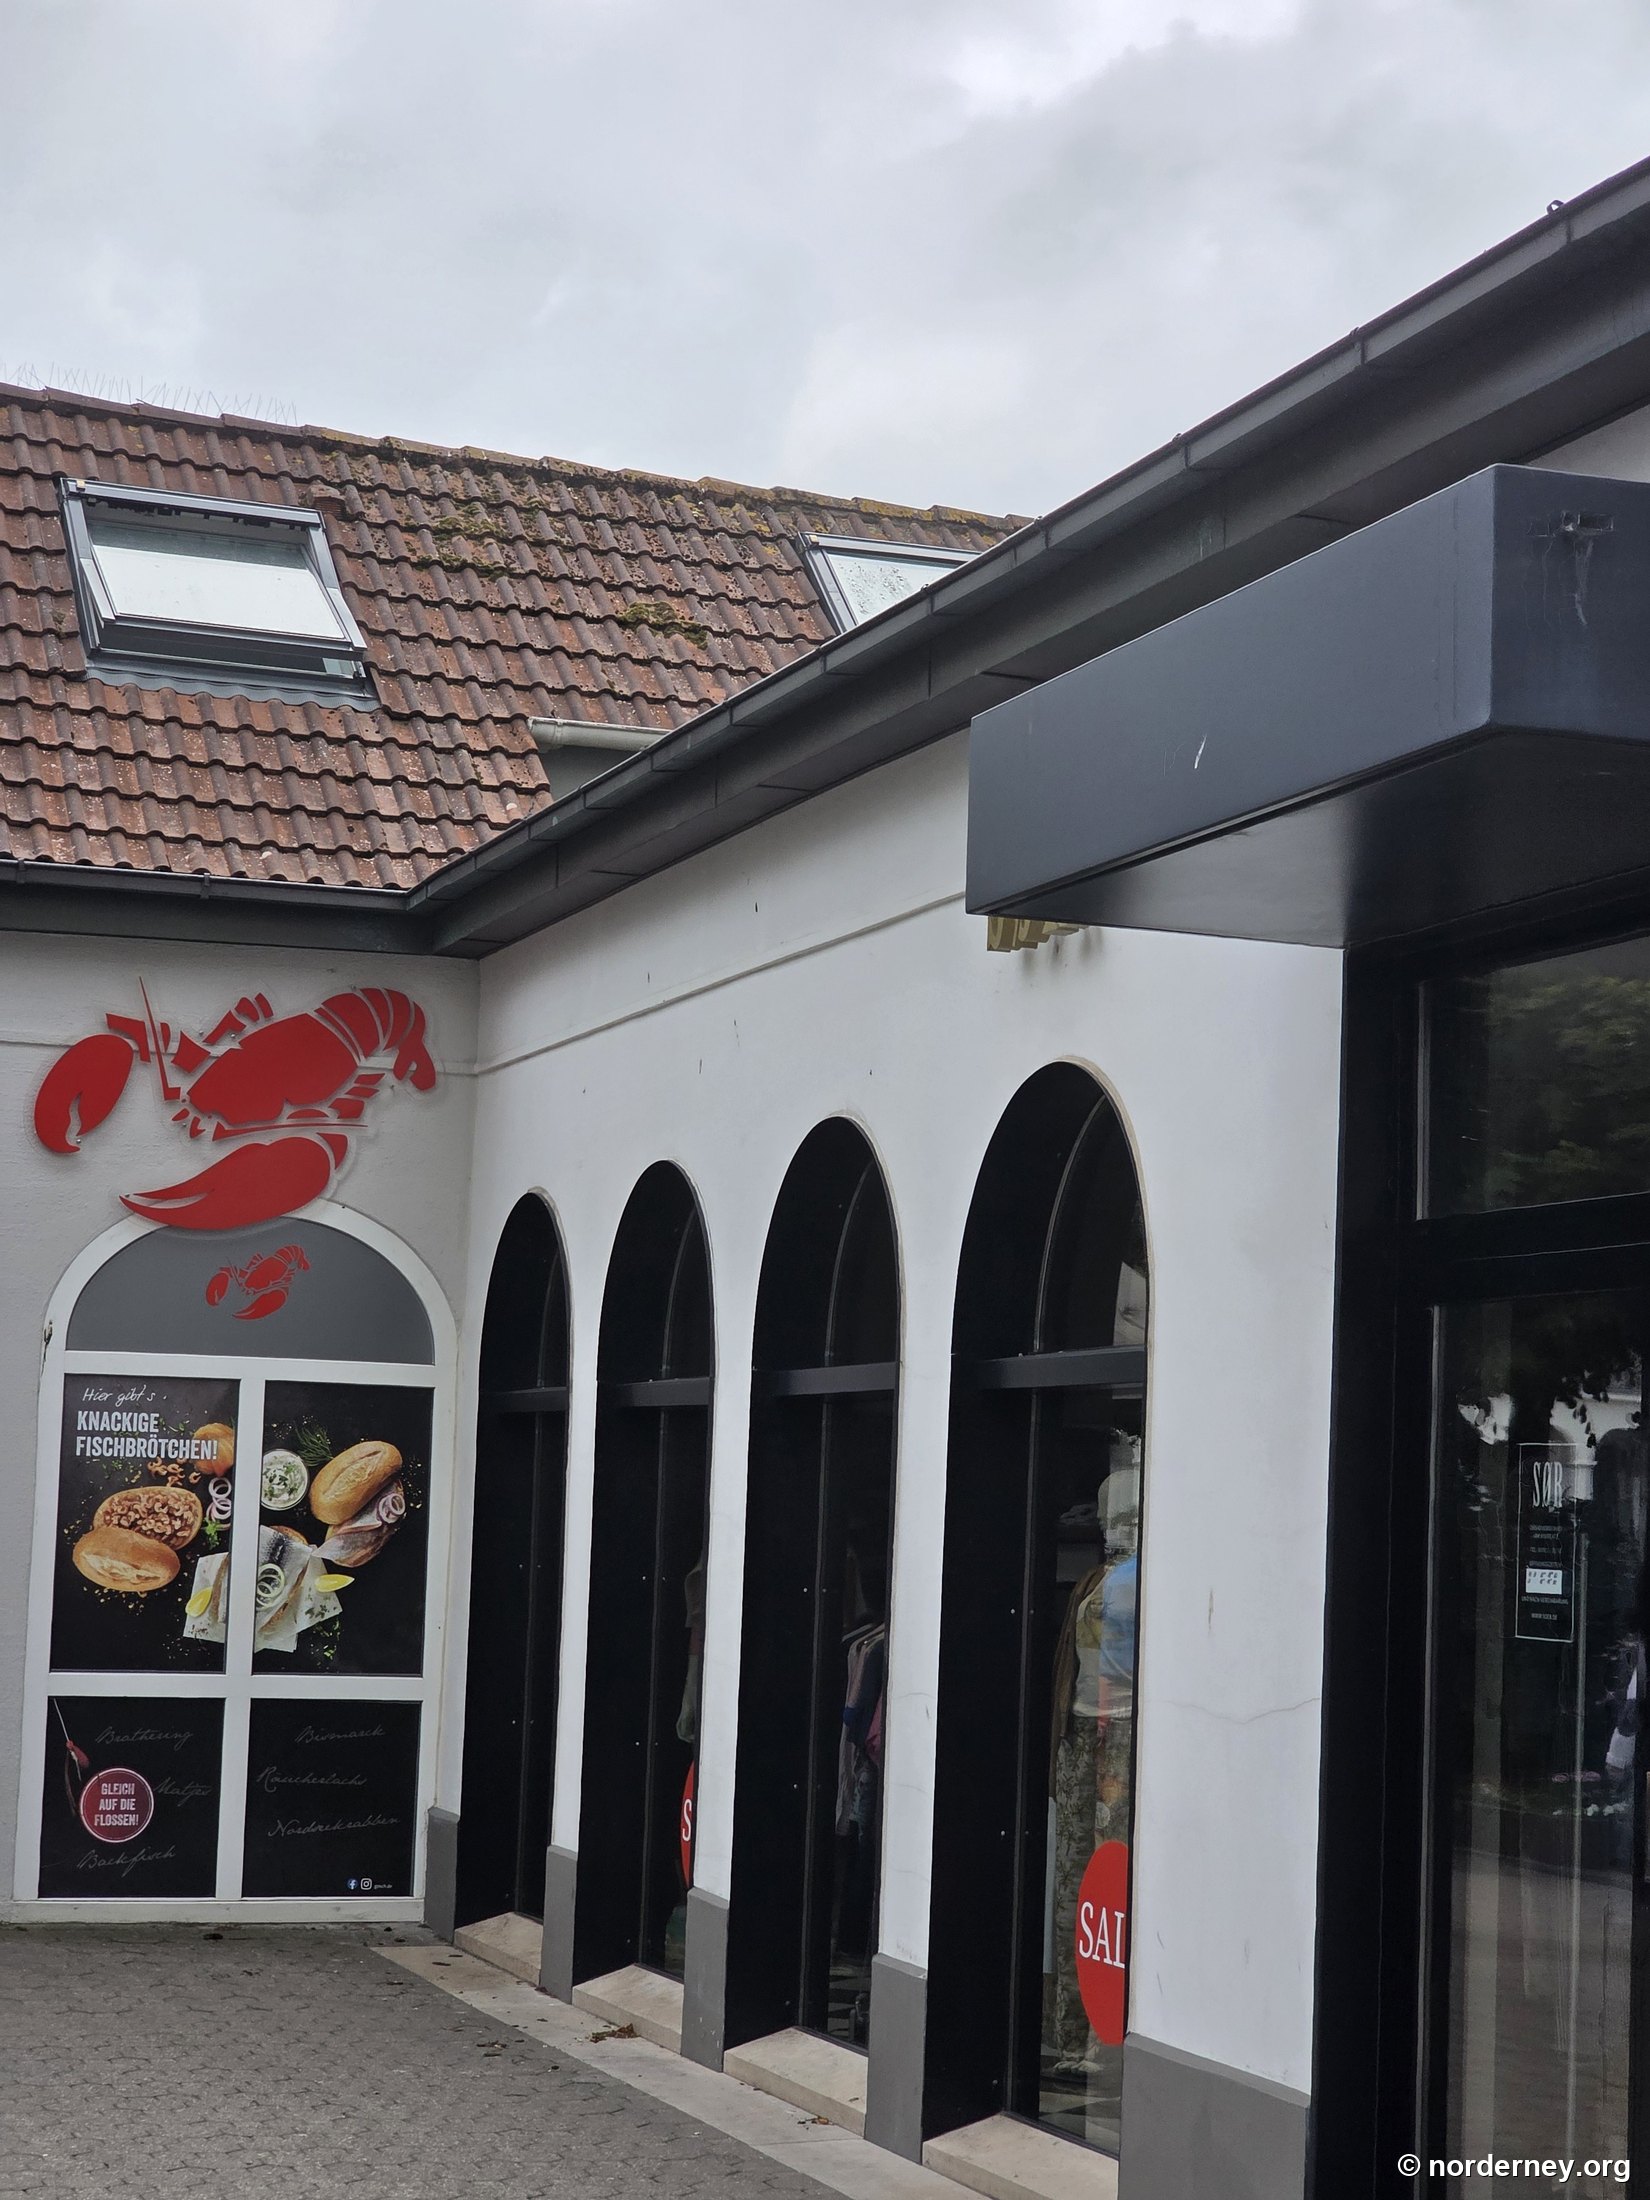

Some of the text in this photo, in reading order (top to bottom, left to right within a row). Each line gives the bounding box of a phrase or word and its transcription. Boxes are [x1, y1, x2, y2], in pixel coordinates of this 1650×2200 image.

[82, 1387, 114, 1402] Hier
[76, 1410, 160, 1433] KNACKIGE
[75, 1434, 218, 1460] FISCHBRÖTCHEN!
[95, 1725, 194, 1751] Brathering
[294, 1724, 386, 1744] Bismarck
[101, 1783, 135, 1796] GLEICH
[98, 1798, 136, 1811] AUF DIE
[94, 1814, 139, 1827] FLOSSEN!
[76, 1844, 177, 1879] Backfisch
